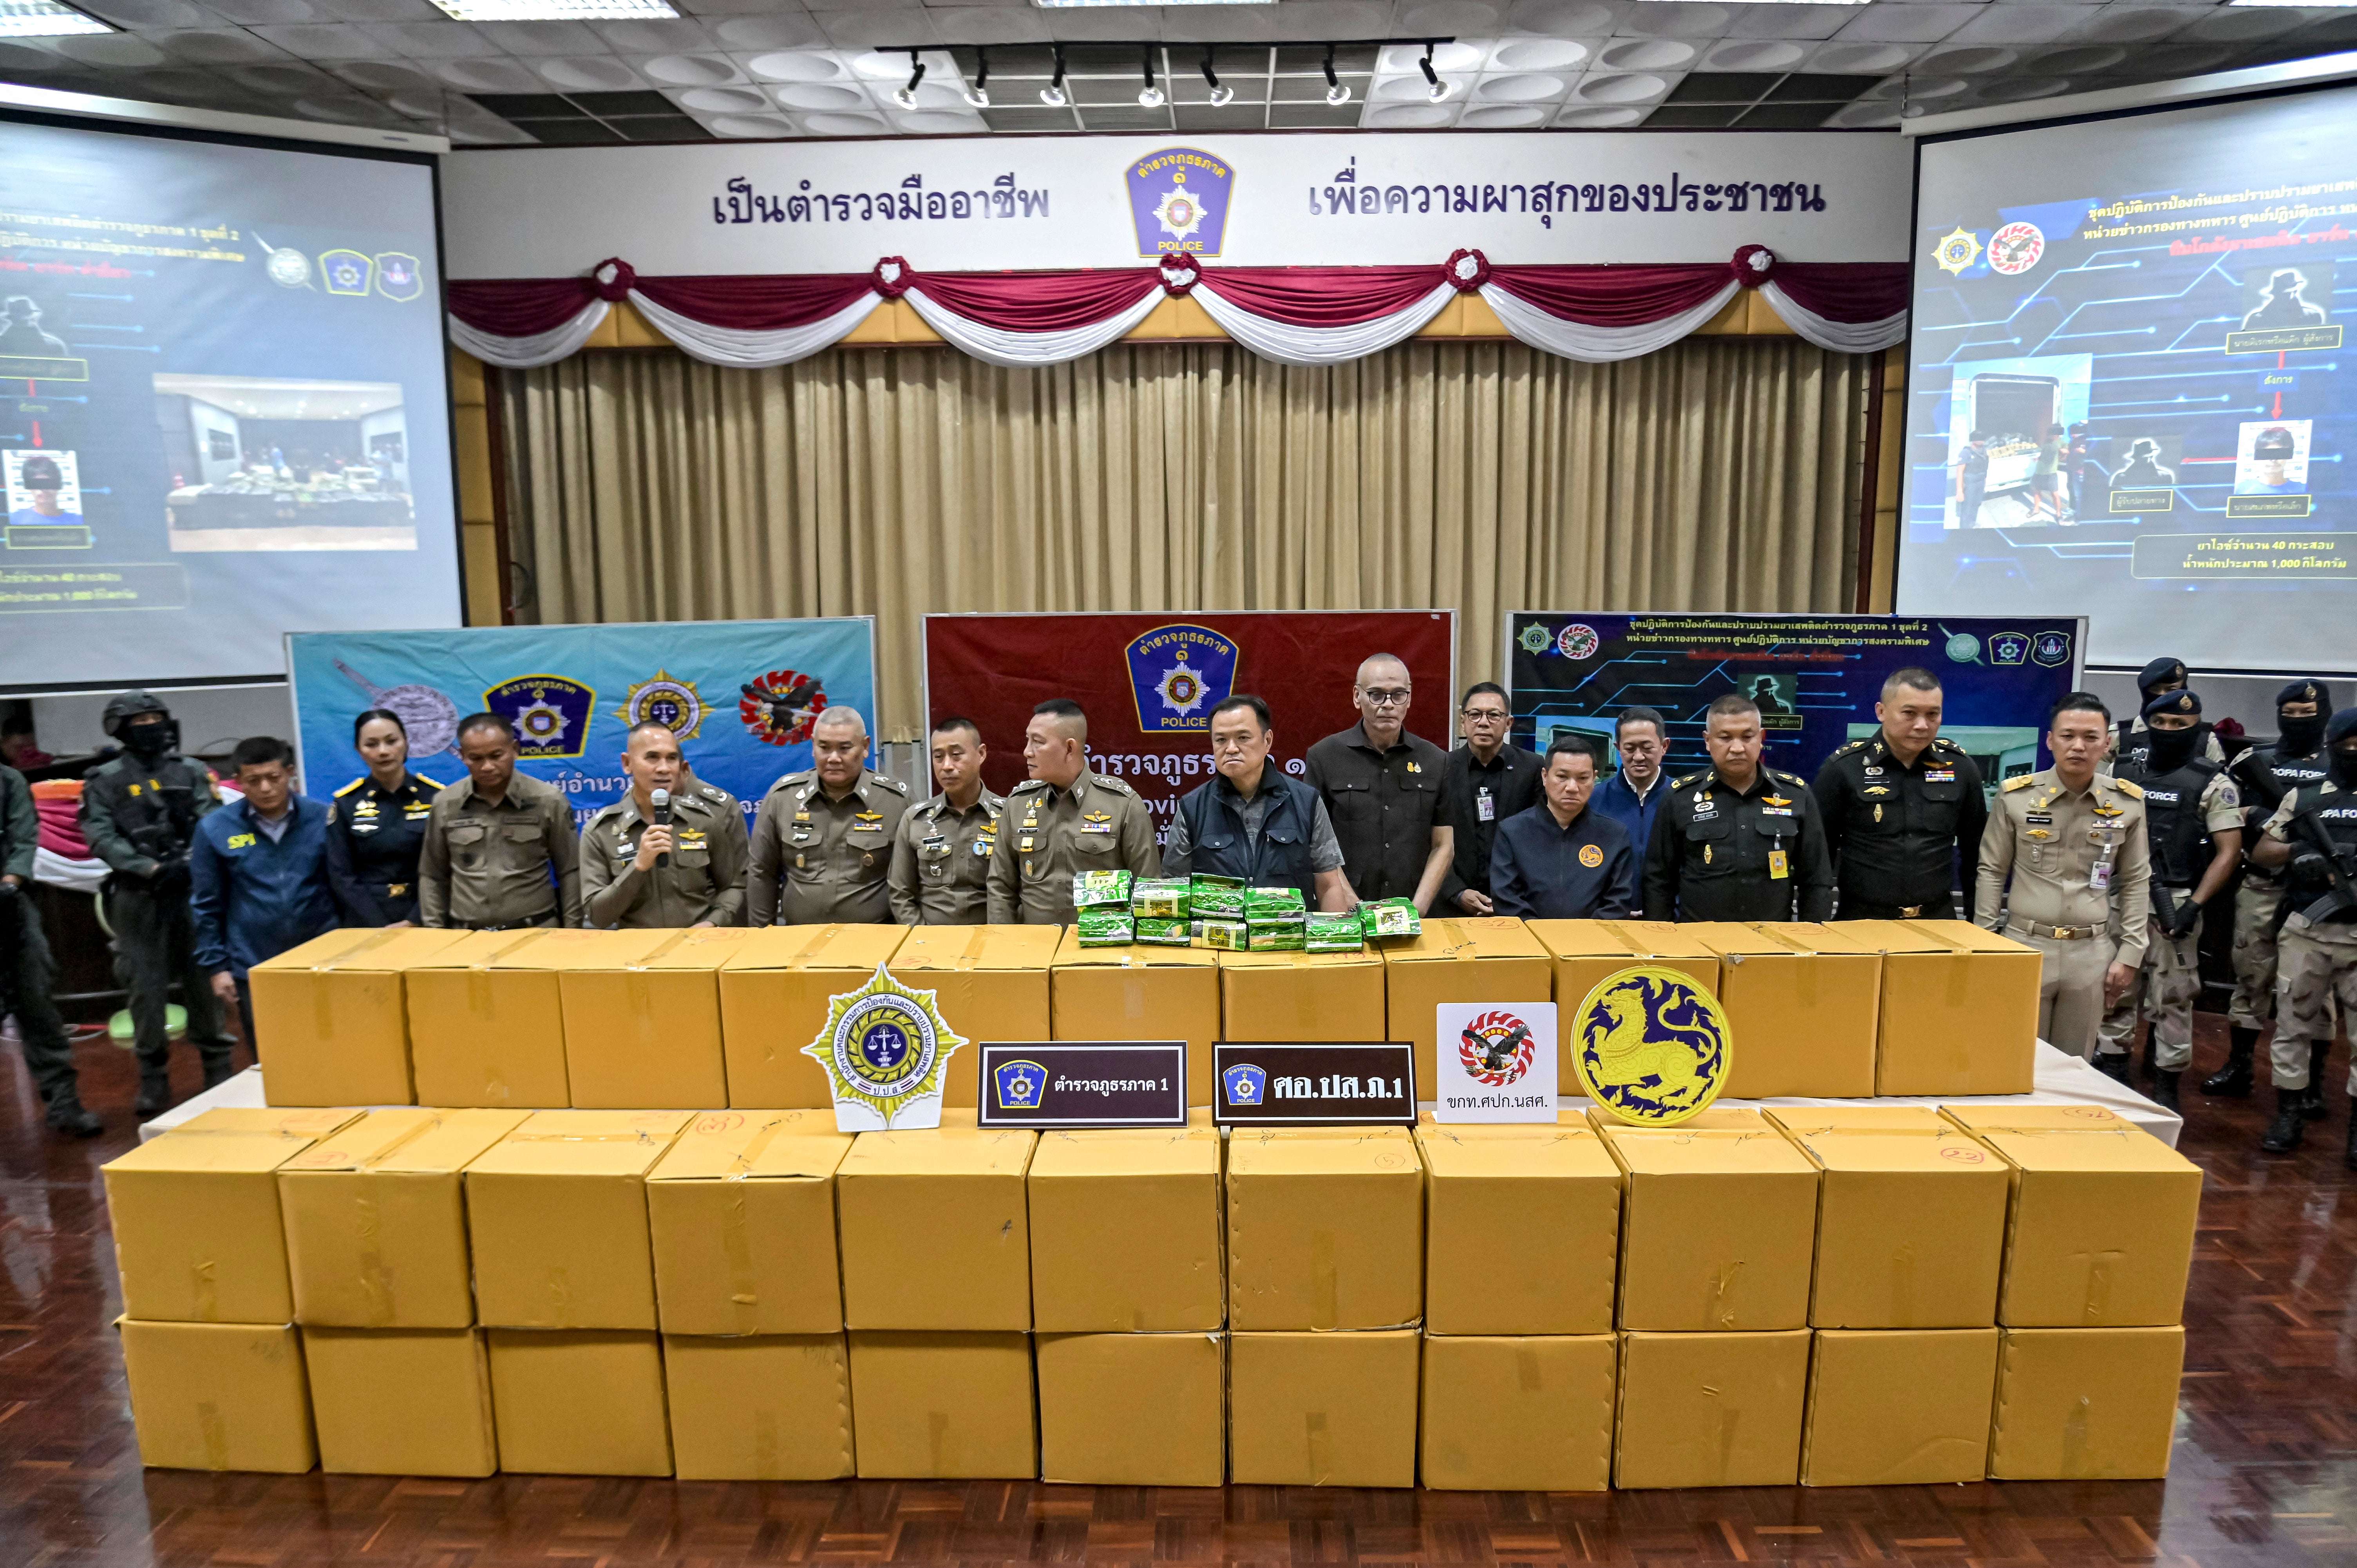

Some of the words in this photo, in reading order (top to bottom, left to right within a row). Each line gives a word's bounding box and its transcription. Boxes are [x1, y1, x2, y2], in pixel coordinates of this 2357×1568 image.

[713, 172, 1049, 223] เป็นตำรวจมืออาชีพ
[1309, 157, 1826, 229] เพื่อความผาสุกของประชาชน
[2088, 179, 2357, 222] ชุดปฏิบัติการป้องกันและปราบปรามยาเสพ
[1158, 241, 1203, 251] POLICE
[2272, 541, 2285, 550] 40
[2288, 541, 2335, 550] กระสอบ
[2272, 559, 2301, 569] 1,000
[1140, 632, 1229, 655] ตำรวจภูธรภาค
[1176, 650, 1188, 661] ๑
[1161, 717, 1207, 727] POLICE
[873, 1083, 901, 1096] ป.ป.ส.
[1055, 1075, 1156, 1097] ตำรวจภูธรภาค
[1161, 1078, 1168, 1091] 1
[1273, 1074, 1403, 1099] ศอ.ปส.ภ.1
[1447, 1093, 1548, 1109] ขกท.ศปก.นสศ.
